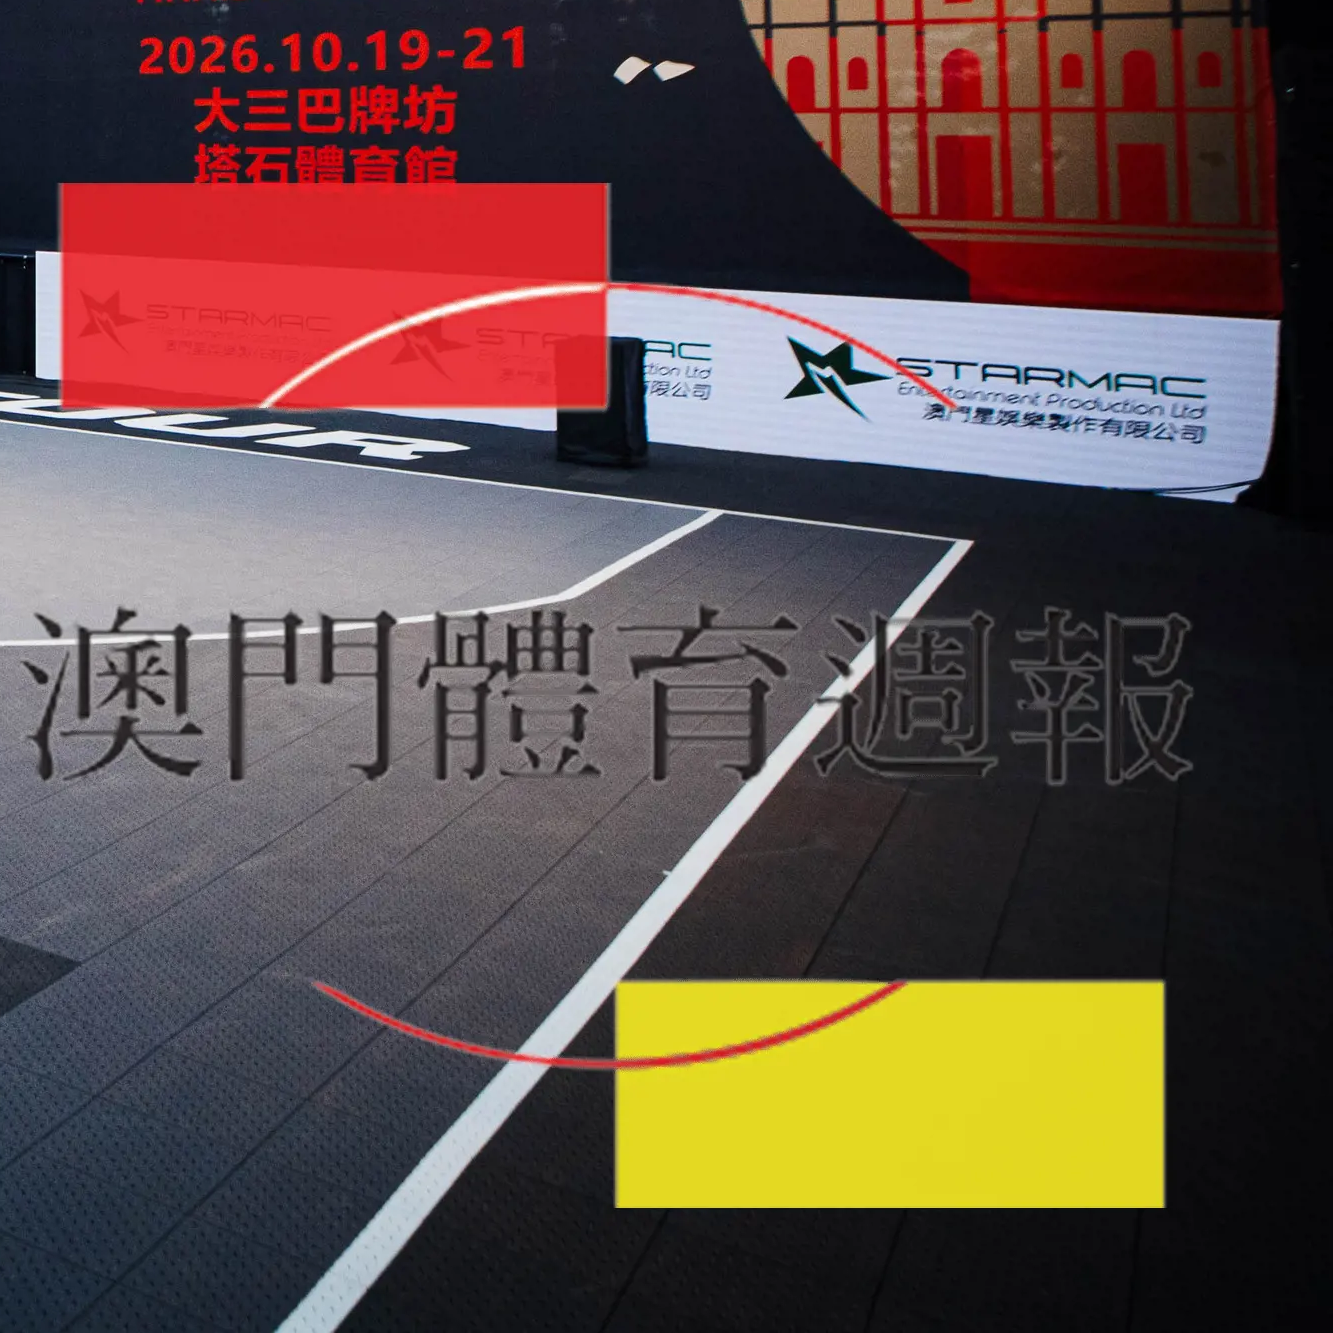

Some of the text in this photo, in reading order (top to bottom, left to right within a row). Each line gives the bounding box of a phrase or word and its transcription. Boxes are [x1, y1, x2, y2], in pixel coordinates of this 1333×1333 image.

[138, 26, 526, 74] 2026.10.19-21
[195, 86, 458, 134] 大三巴牌坊
[195, 144, 458, 185] 塔石體育館
[895, 356, 1207, 400] STARMAC
[1046, 394, 1163, 414] Production
[1171, 404, 1206, 419] Ltd
